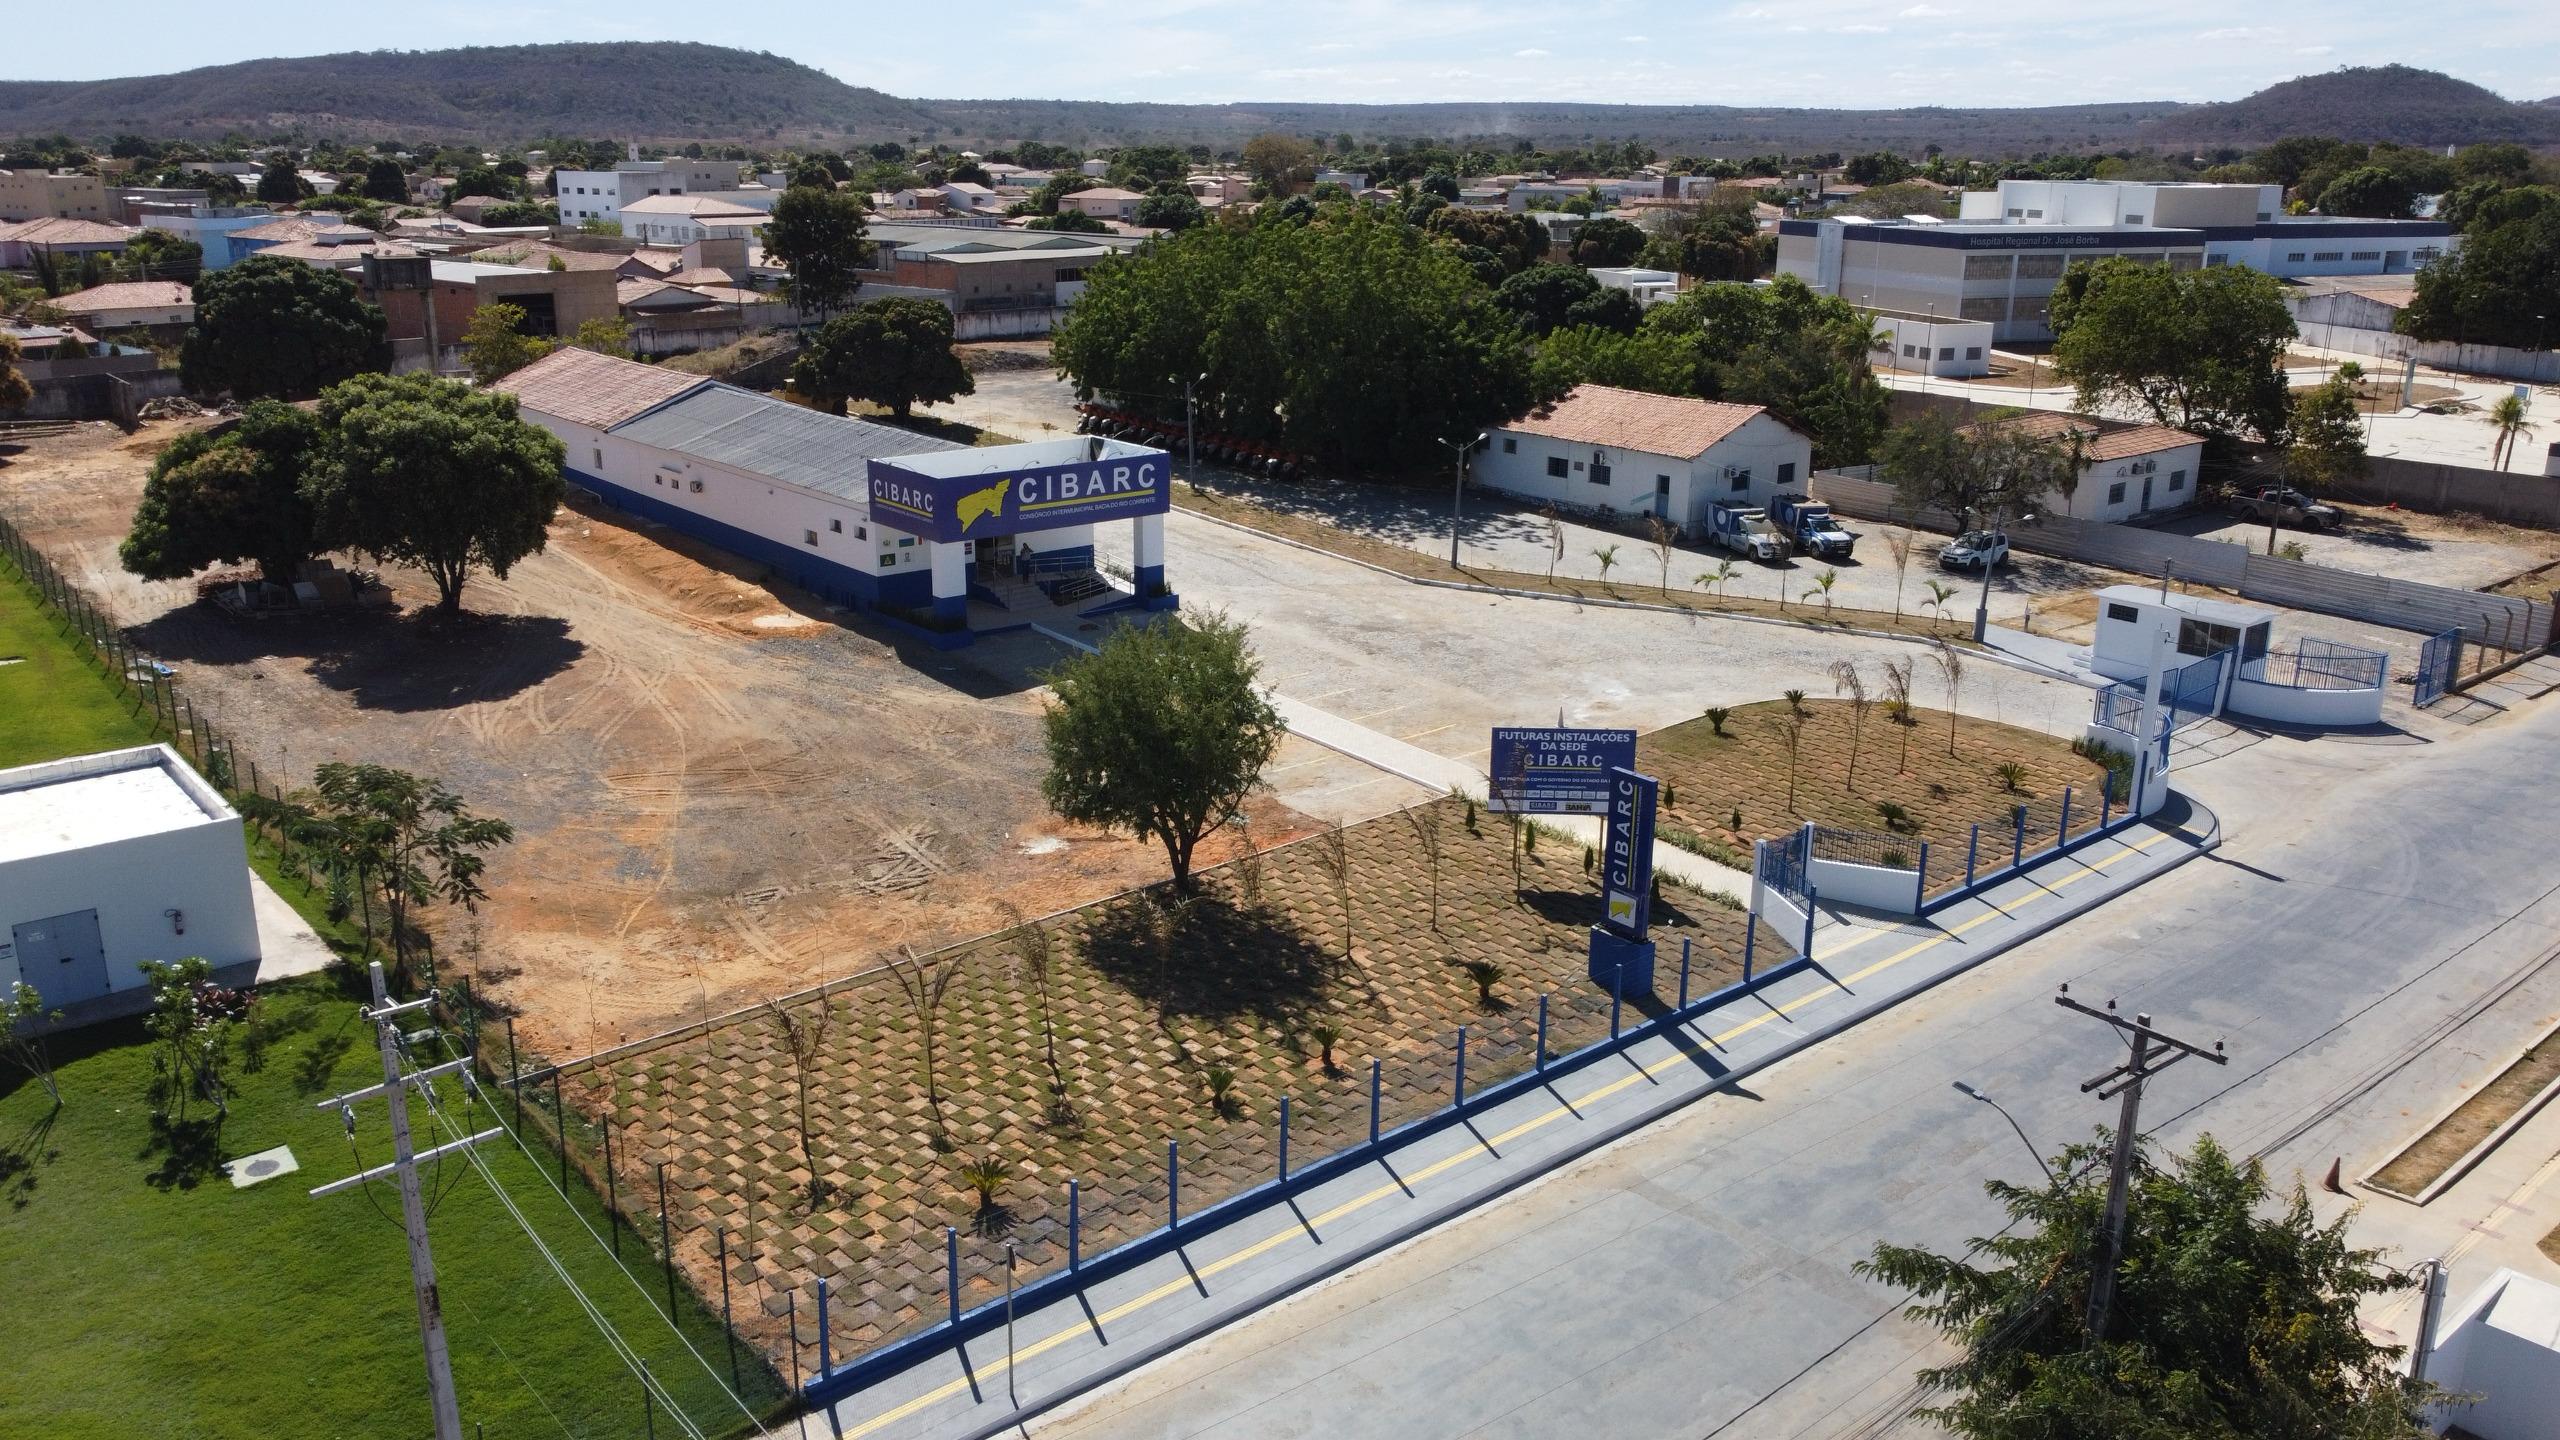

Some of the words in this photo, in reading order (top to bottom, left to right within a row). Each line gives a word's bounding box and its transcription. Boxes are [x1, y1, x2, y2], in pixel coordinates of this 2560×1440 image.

[1970, 236, 2004, 247] Hospital
[2005, 236, 2041, 247] Regional
[2042, 236, 2053, 245] Dr.
[2055, 236, 2074, 245] José
[2075, 235, 2100, 245] Borba
[1018, 463, 1156, 504] CIBARC
[874, 479, 934, 512] CIBARC
[1019, 510, 1052, 520] CONSÓRCIO
[1052, 505, 1095, 516] INTERMUNICIPAL
[1129, 497, 1157, 506] CORRENTE
[1499, 731, 1550, 741] FUTURAS
[1553, 732, 1630, 744] INSTALAÇÕES
[1541, 742, 1557, 751] DA
[1560, 742, 1588, 751] SEDE
[1524, 753, 1603, 767] CIBARC
[1613, 780, 1634, 886] CIBARC
